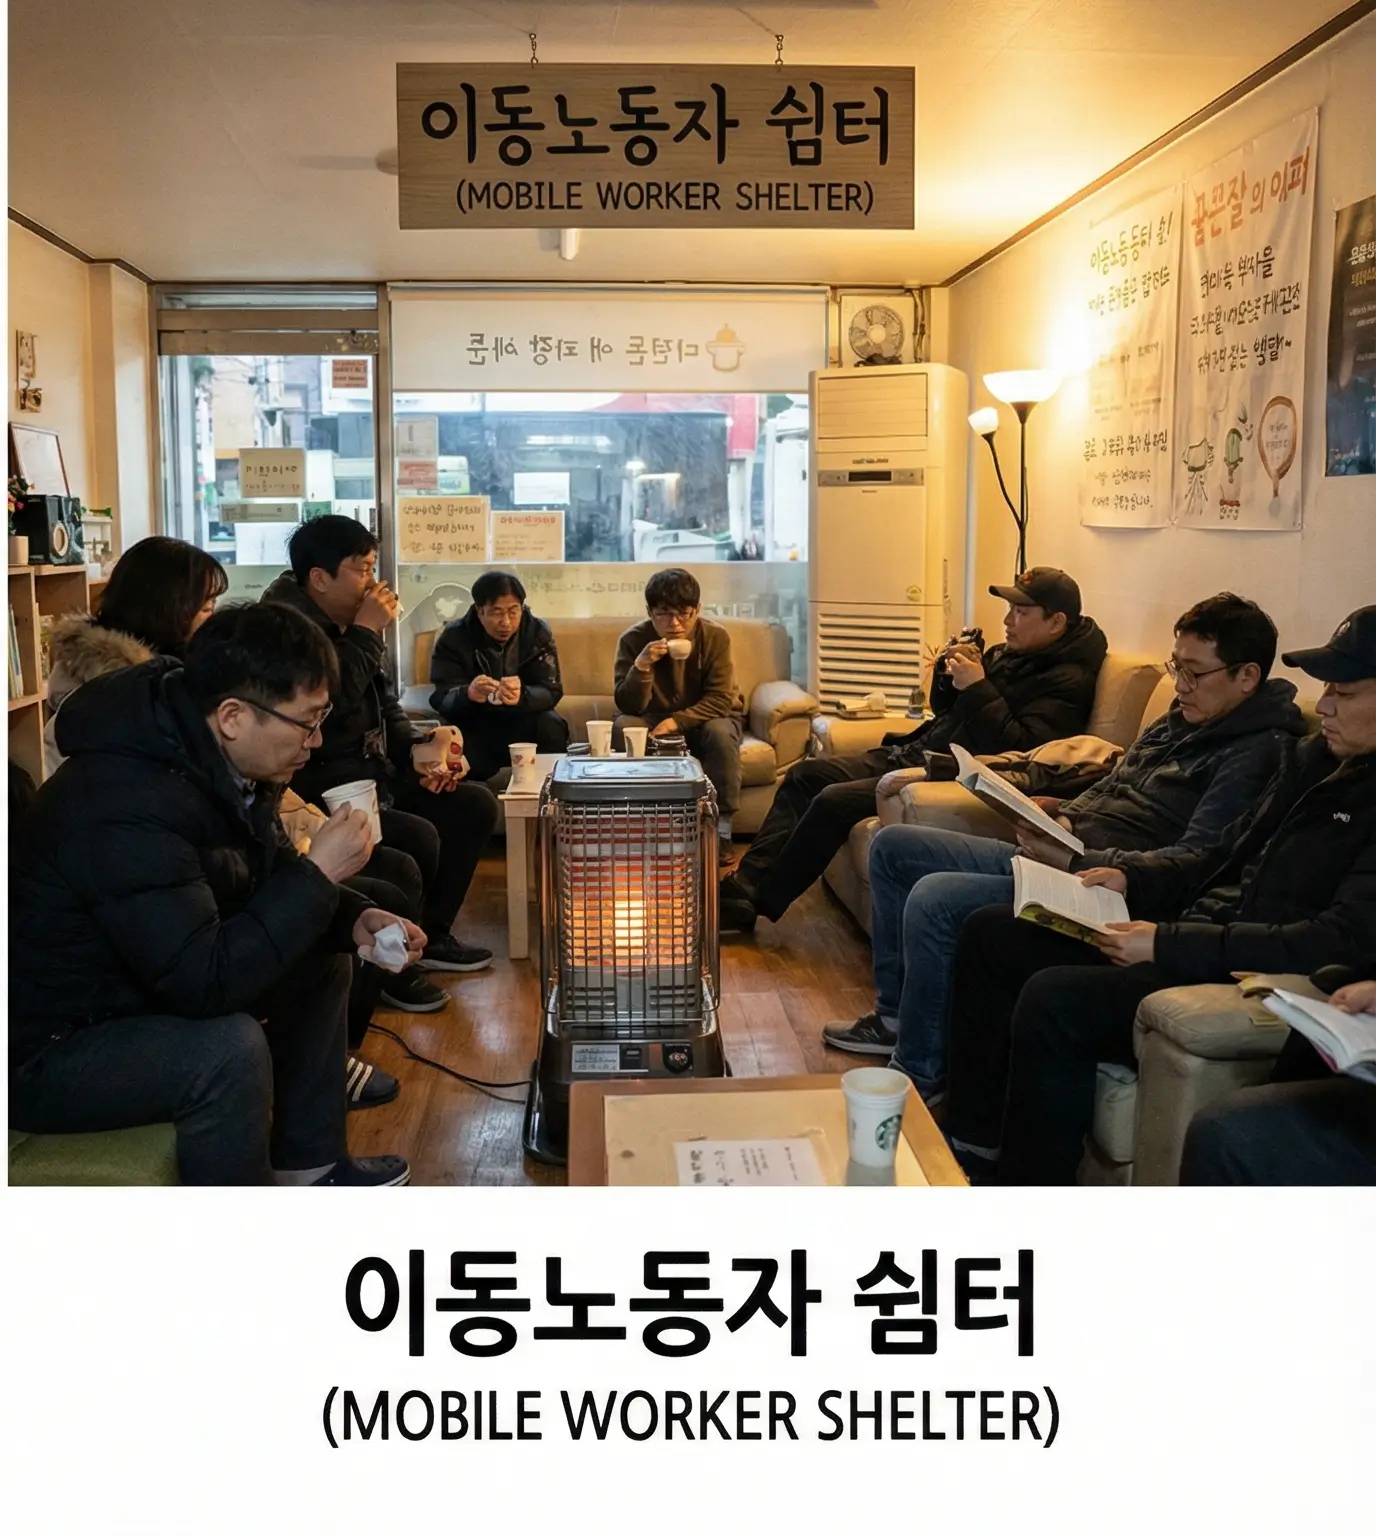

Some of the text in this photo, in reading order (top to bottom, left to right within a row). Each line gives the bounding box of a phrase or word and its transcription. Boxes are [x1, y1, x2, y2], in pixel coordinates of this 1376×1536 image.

[421, 81, 889, 167] 이동노동자 쉼터
[456, 178, 874, 216] (MOBILE WORKER SHELTER)
